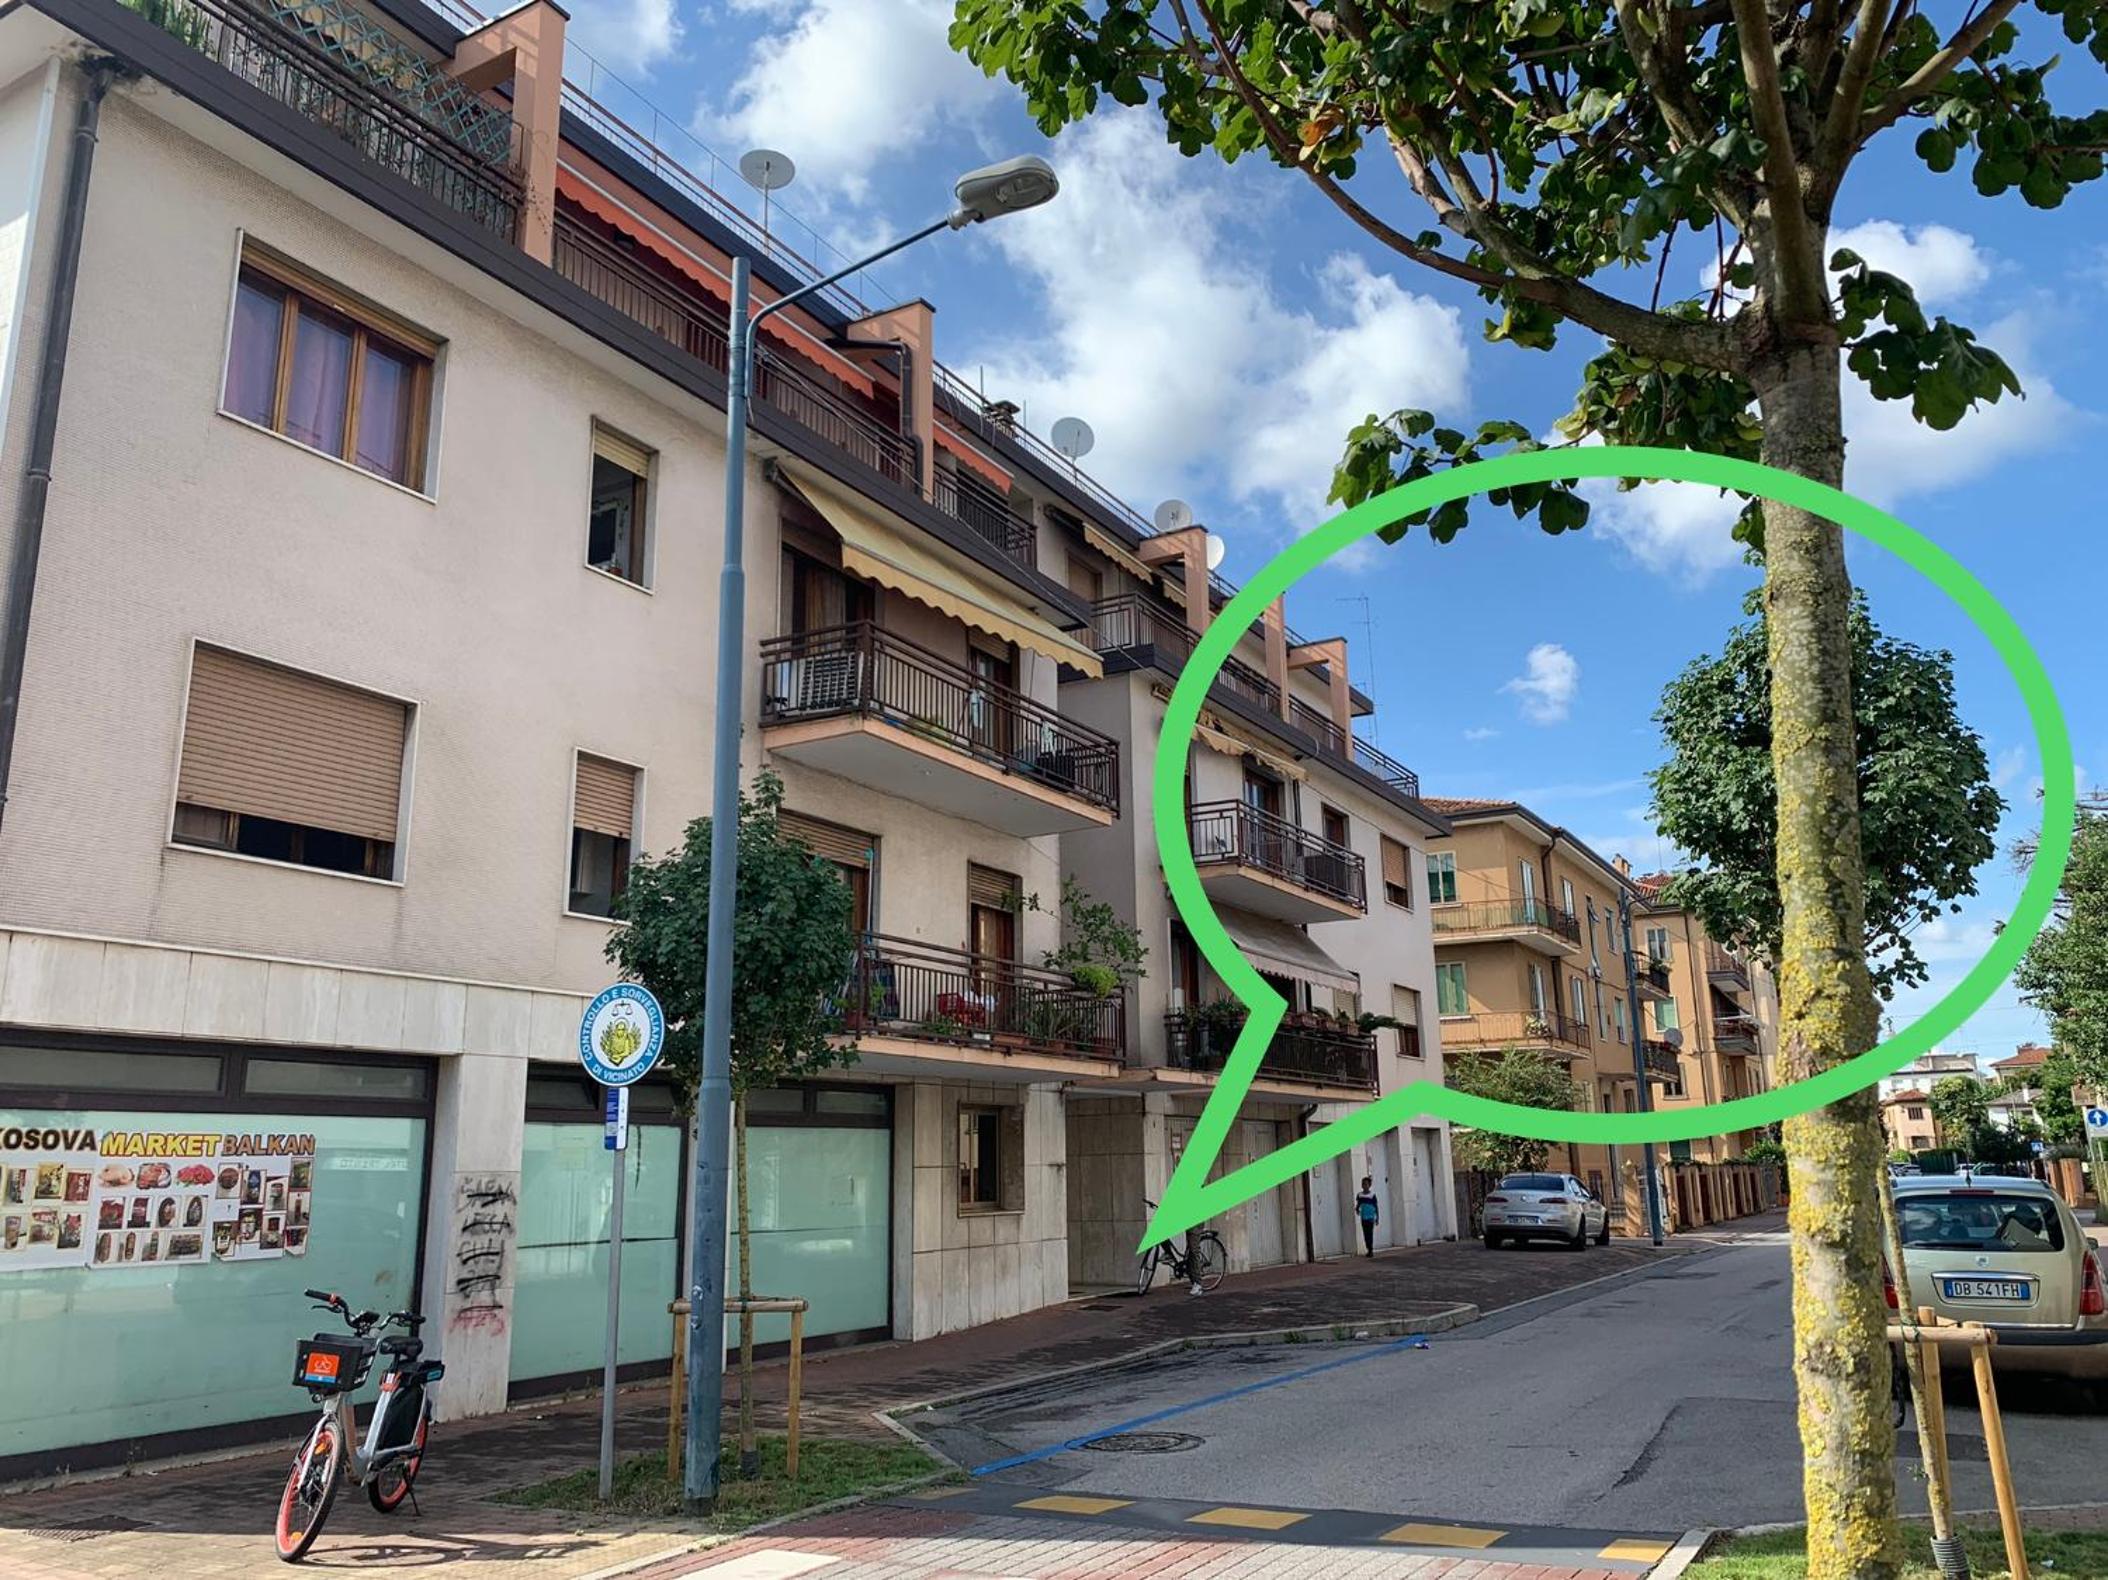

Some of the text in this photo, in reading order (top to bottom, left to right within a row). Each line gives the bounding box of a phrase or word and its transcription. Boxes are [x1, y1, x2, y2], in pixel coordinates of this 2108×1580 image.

[581, 988, 660, 1061] CONTROLLO E SORVEGLIANZA
[592, 1062, 645, 1082] DI VICINATO
[0, 1127, 315, 1158] OSOVA MARKET BALKAN
[1954, 1282, 1971, 1296] DB
[1976, 1281, 2020, 1297] 541FH
